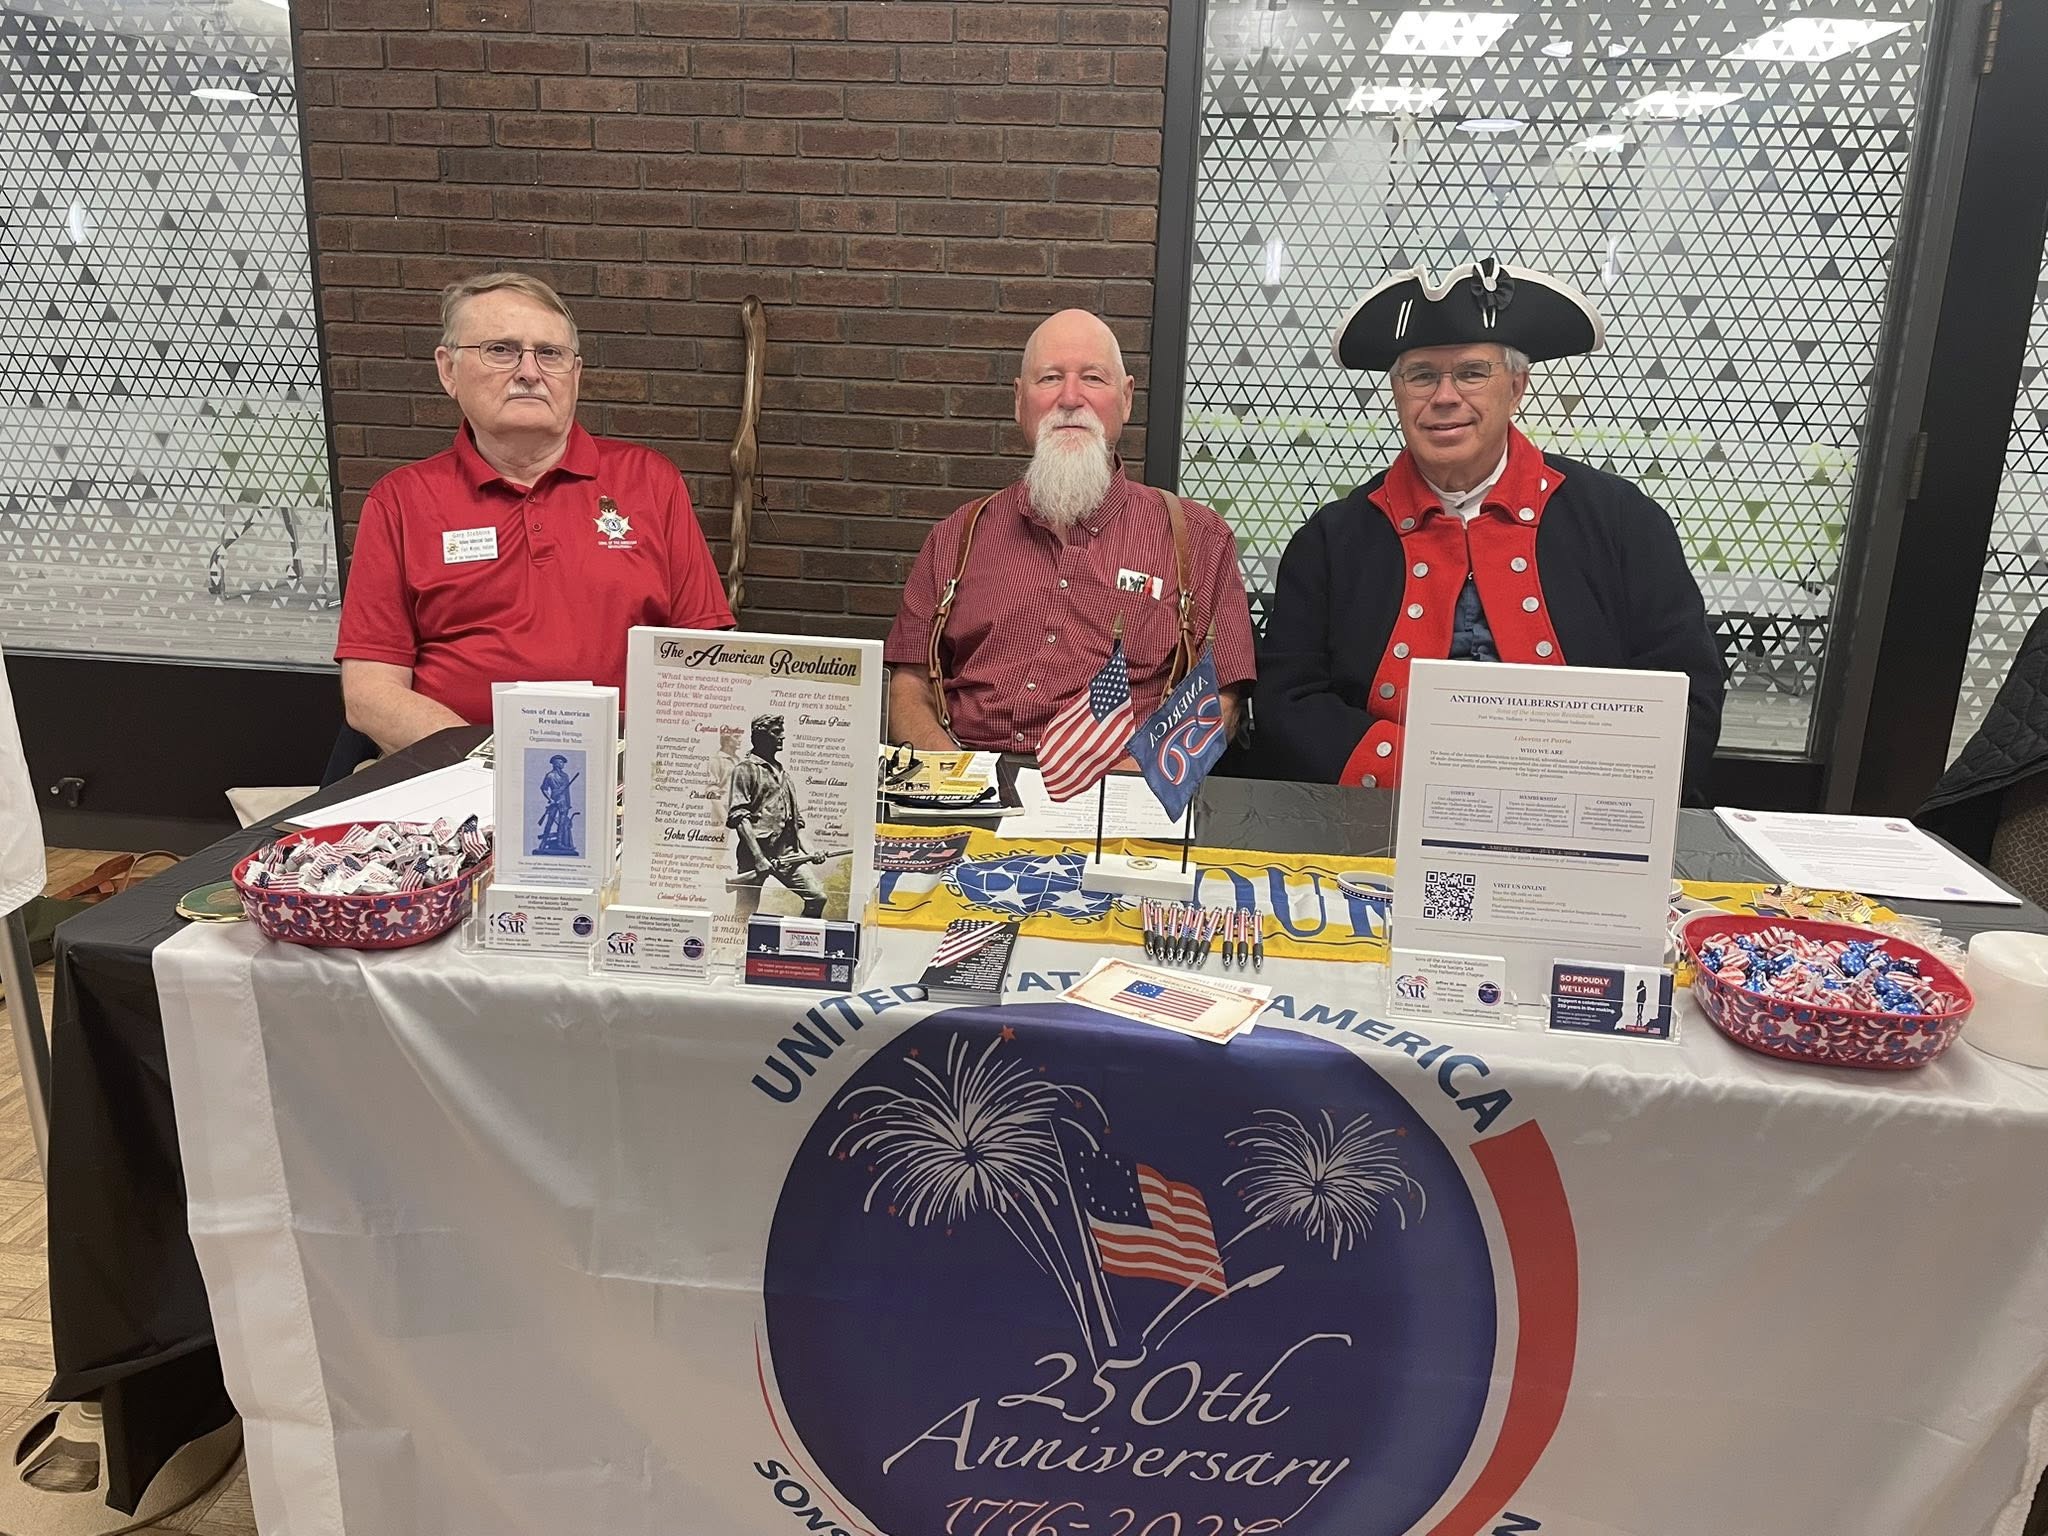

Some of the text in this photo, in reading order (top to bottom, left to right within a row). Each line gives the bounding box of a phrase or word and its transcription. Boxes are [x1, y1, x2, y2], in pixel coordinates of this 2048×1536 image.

[660, 641, 856, 676] The American Revolution
[673, 700, 707, 709] governed
[788, 701, 799, 709] try
[1450, 695, 1644, 714] ANTHONY HALBERSTADT CHAPTER
[685, 710, 712, 718] always
[799, 714, 850, 727] Thomas Paine
[656, 809, 671, 817] King
[673, 810, 696, 818] George
[664, 827, 725, 843] John Hancock
[1492, 882, 1510, 890] VISIT
[1522, 884, 1547, 892] ONLINE
[713, 914, 748, 923] politics
[498, 921, 525, 933] SAR
[720, 927, 740, 935] may
[607, 942, 635, 955] SAR
[1573, 976, 1610, 985] PROUDLY
[1397, 983, 1425, 999] SAR
[1560, 985, 1582, 993] WE'LL
[751, 983, 929, 1103] UNITED
[1263, 994, 1513, 1134] AMERICA
[996, 1333, 1353, 1427] 250th
[882, 1398, 1351, 1524] Anniversary
[754, 1460, 851, 1536] SON
